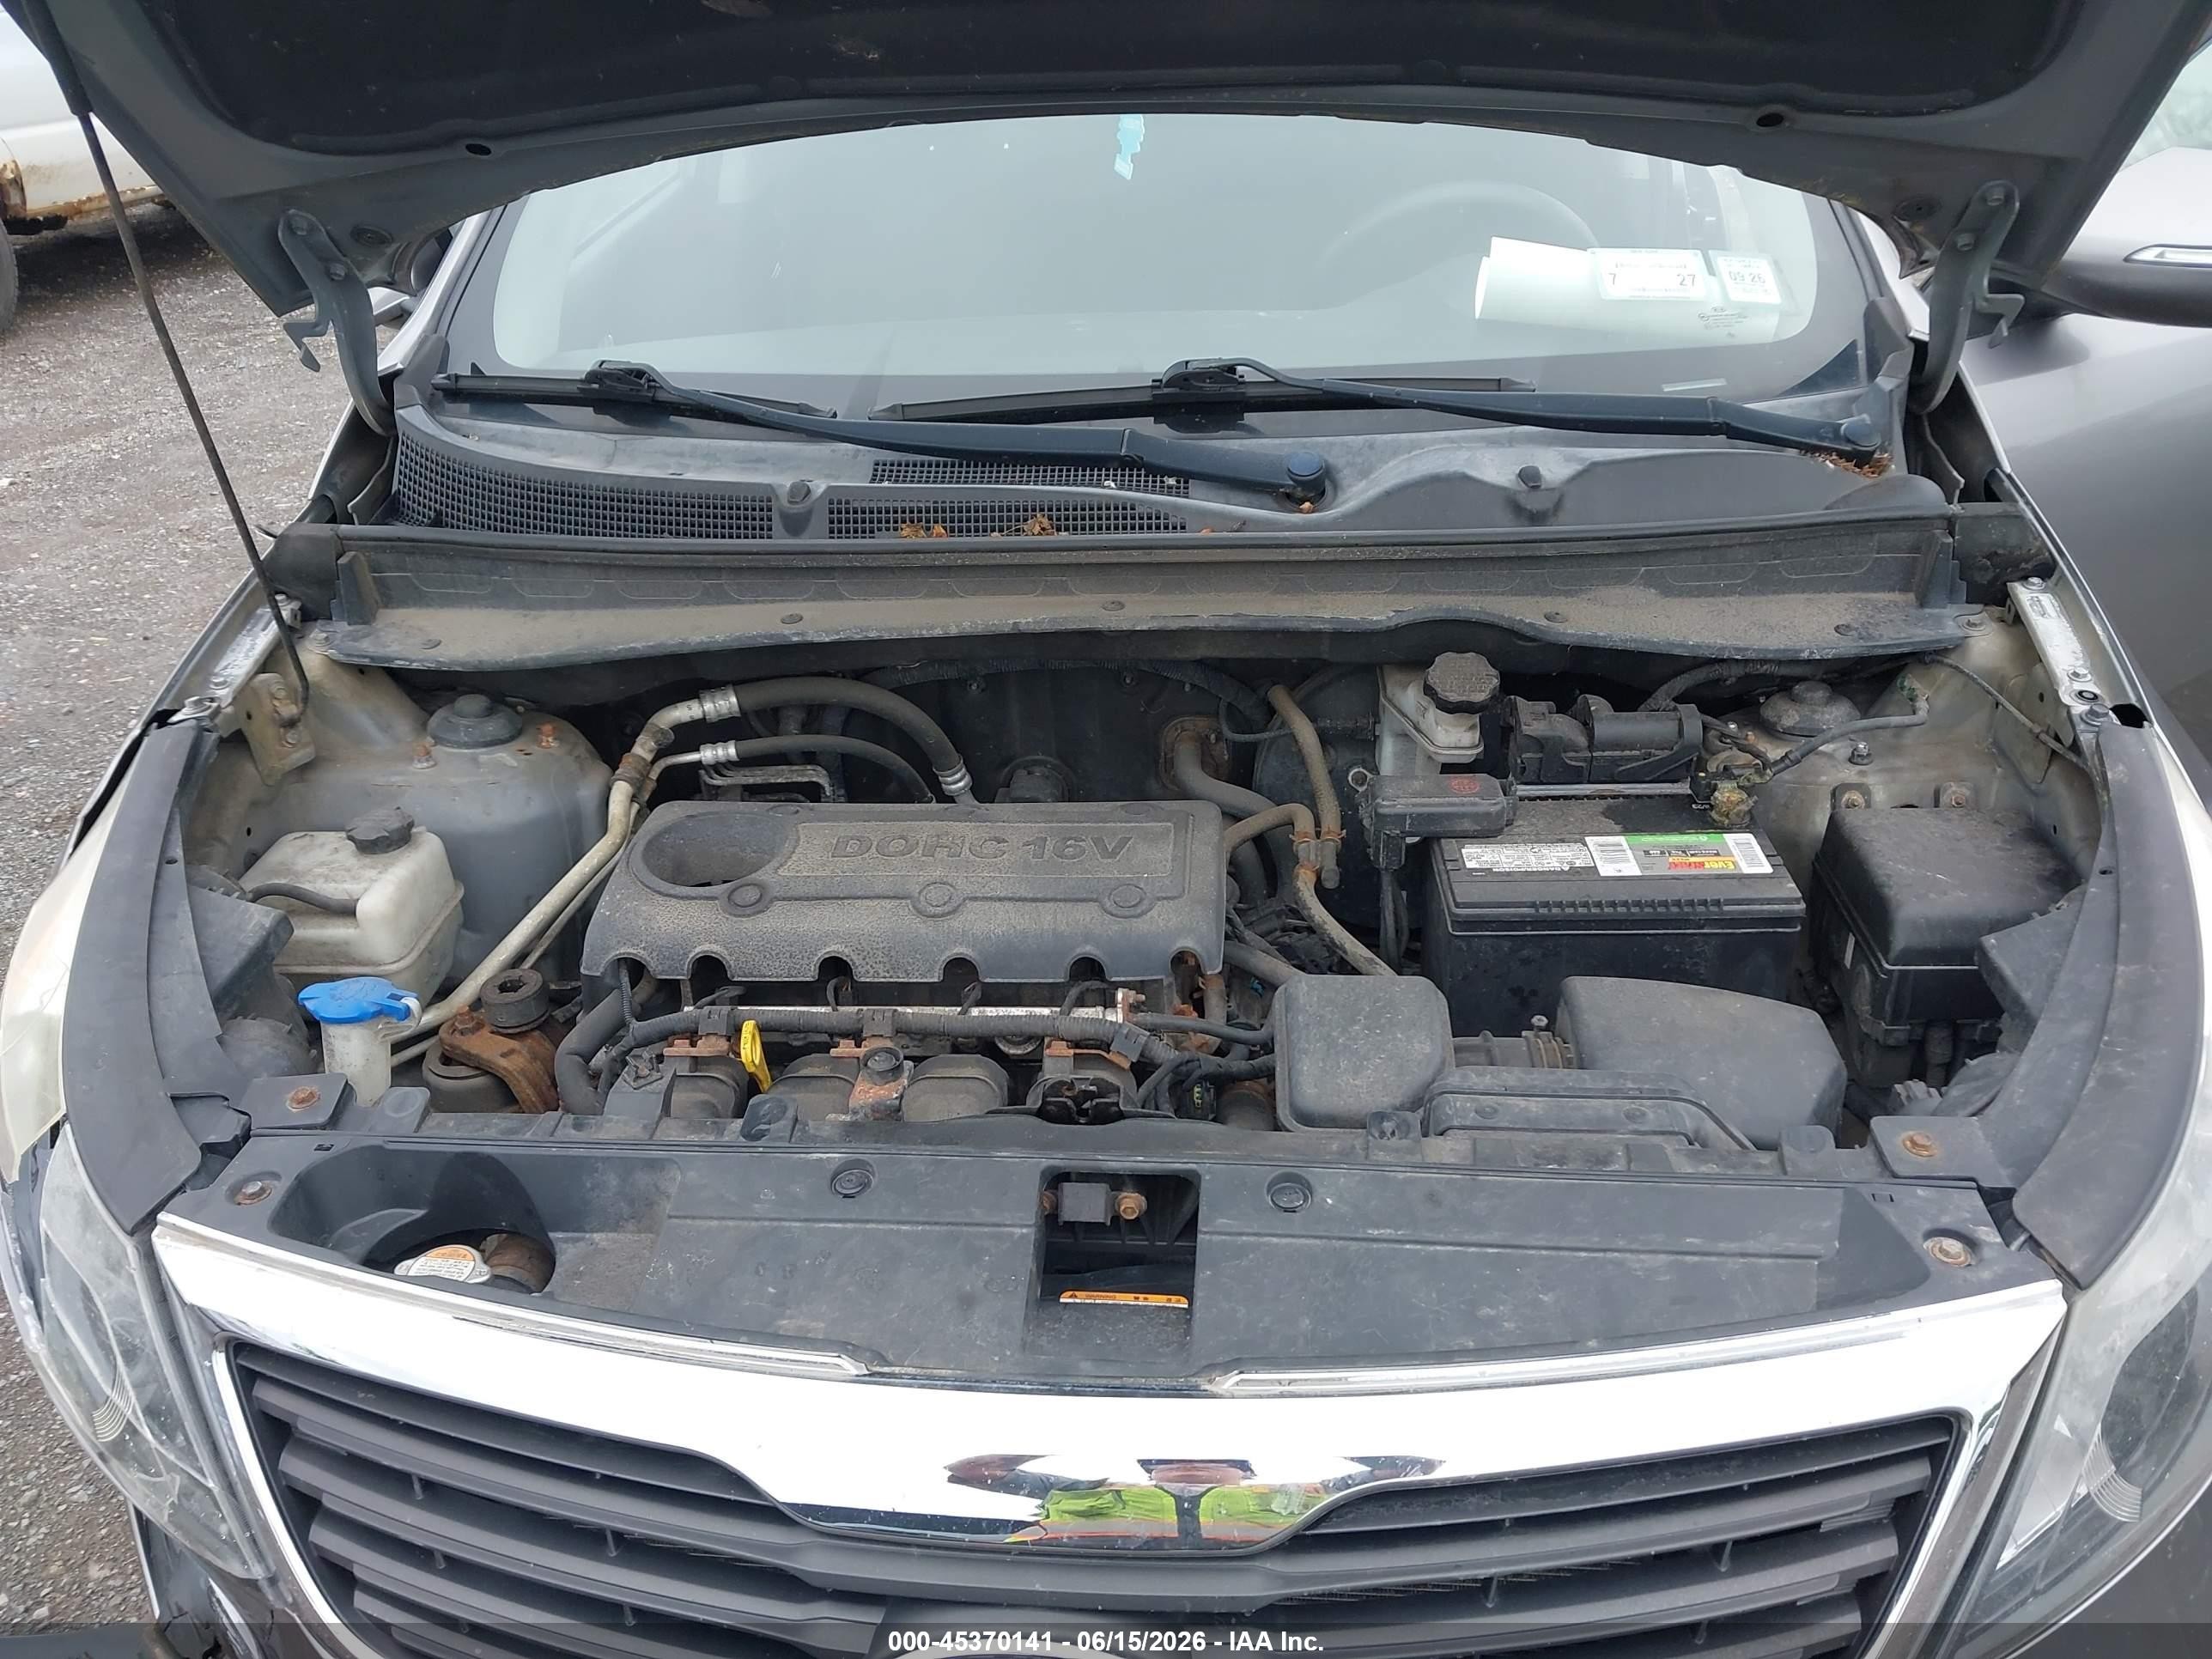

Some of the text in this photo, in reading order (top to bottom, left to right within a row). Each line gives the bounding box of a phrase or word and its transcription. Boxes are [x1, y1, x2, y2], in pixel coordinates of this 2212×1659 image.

[1676, 273, 1696, 287] 27
[1748, 272, 1766, 284] 26
[830, 834, 1134, 861] DOHC 16V
